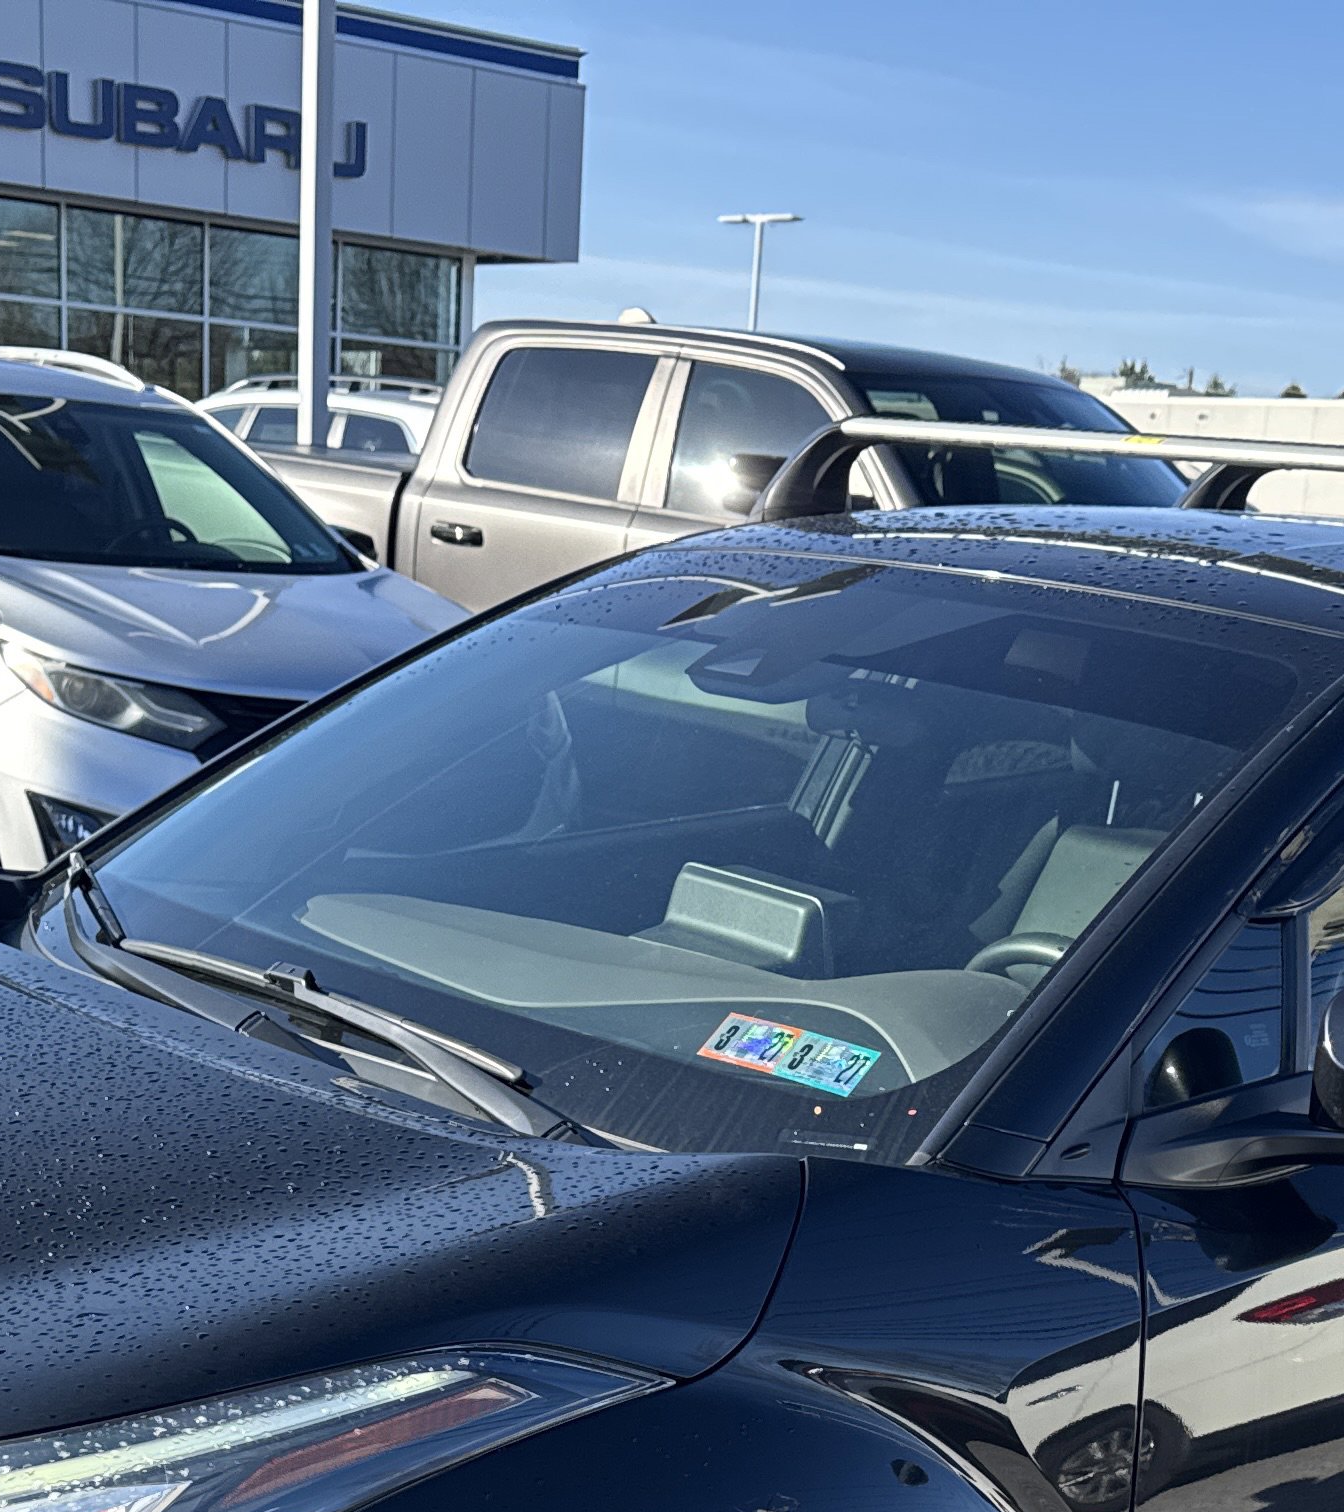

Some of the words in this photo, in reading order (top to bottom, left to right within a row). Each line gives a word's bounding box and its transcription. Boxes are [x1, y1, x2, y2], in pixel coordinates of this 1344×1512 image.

[714, 1025, 740, 1050] 3
[758, 1032, 795, 1062] 27
[787, 1043, 813, 1070] 3
[833, 1053, 870, 1085] 27
